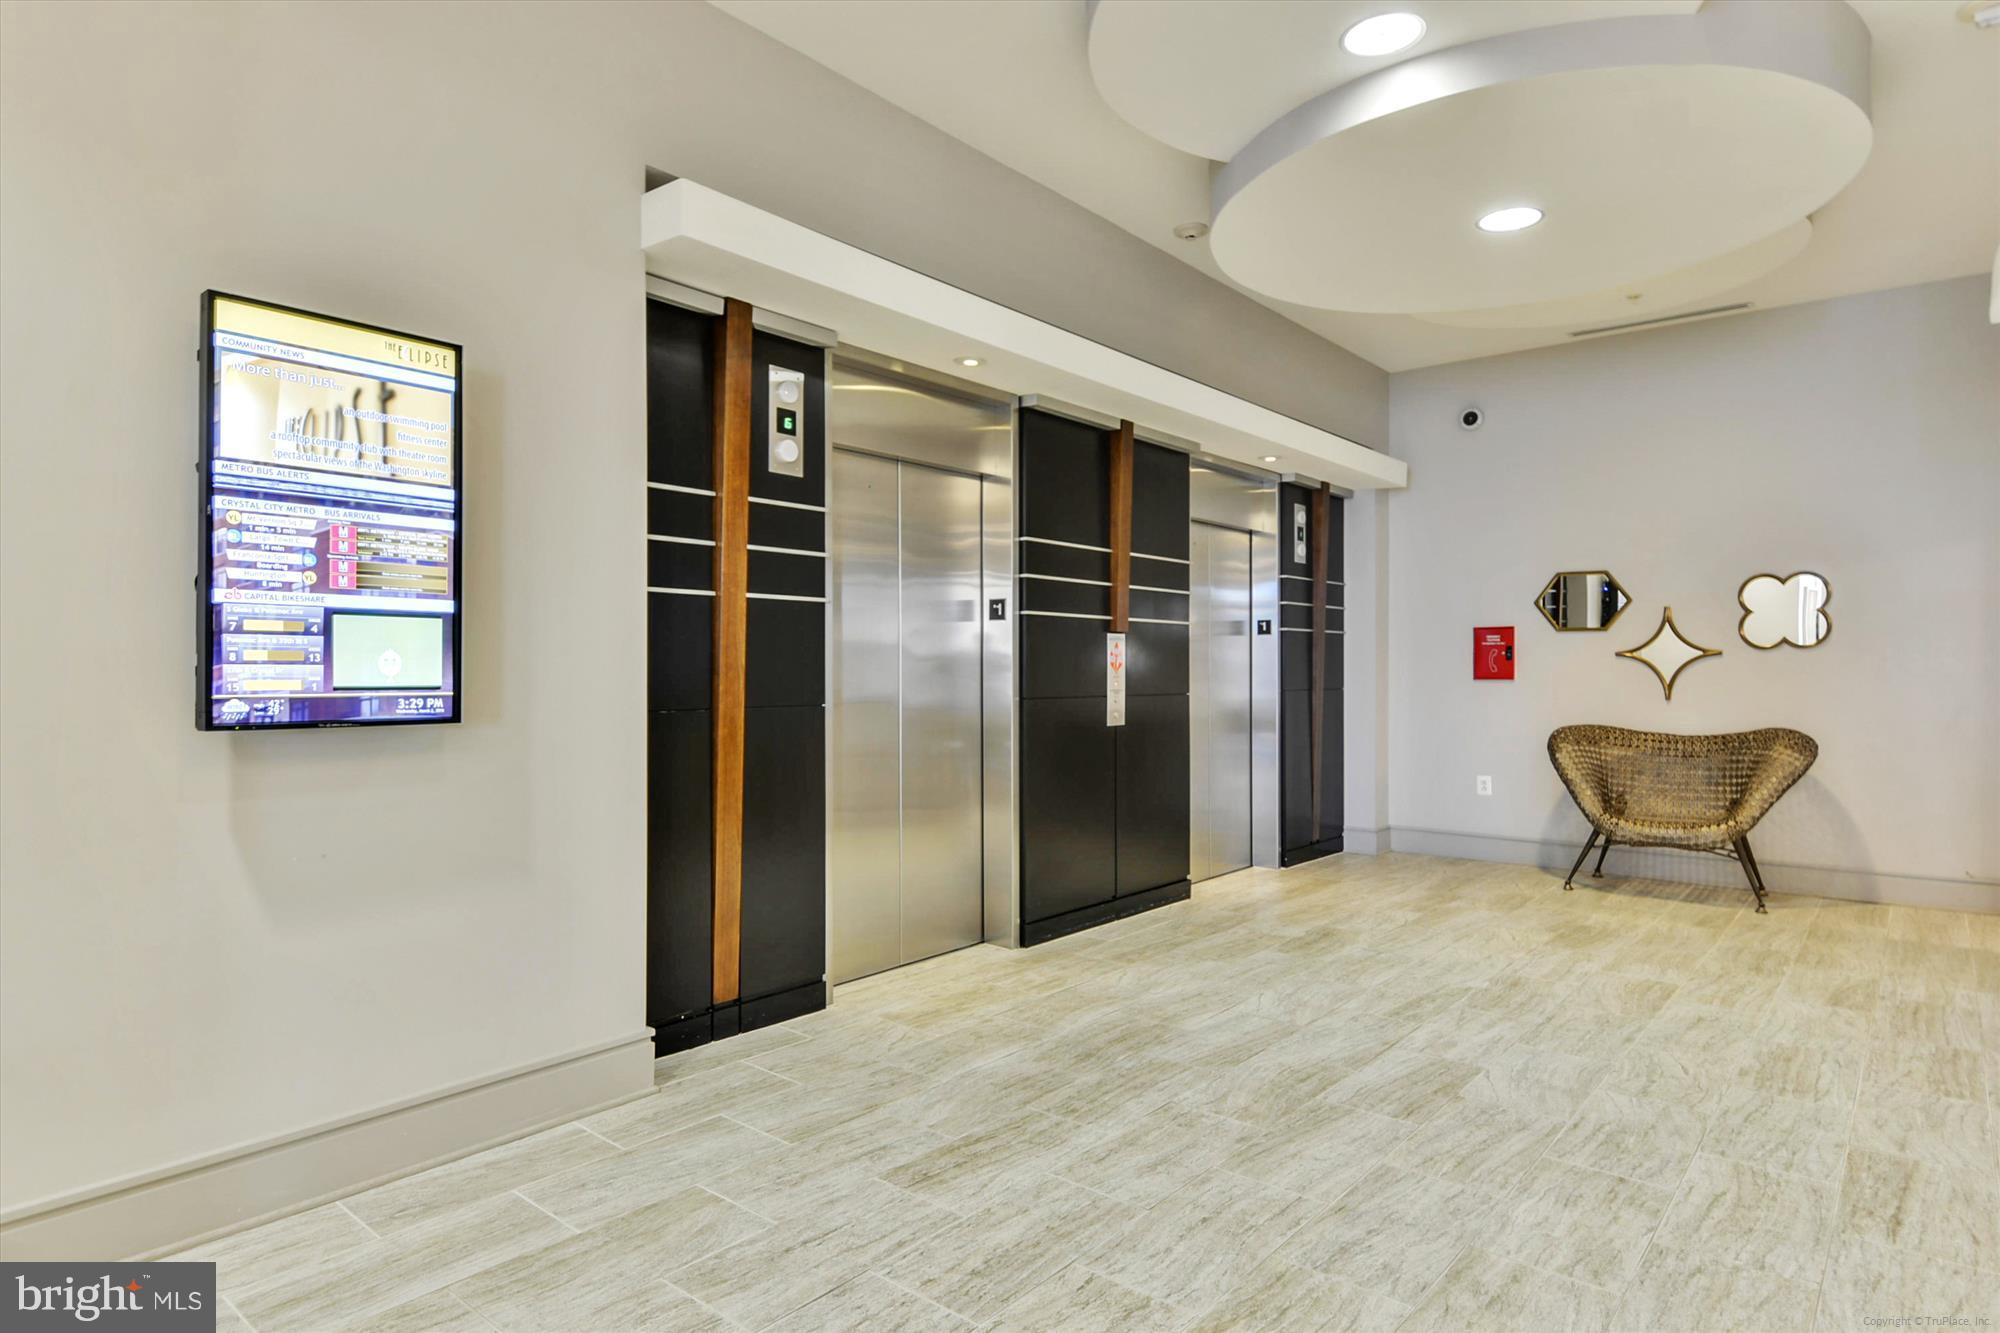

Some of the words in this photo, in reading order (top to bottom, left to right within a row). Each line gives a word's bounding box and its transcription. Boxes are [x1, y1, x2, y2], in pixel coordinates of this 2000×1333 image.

[222, 337, 277, 353] COMMUNITY
[280, 348, 305, 360] NEWS
[231, 360, 271, 376] More
[275, 367, 306, 383] than
[356, 410, 389, 422] outdoor
[389, 416, 430, 431] swimming
[430, 422, 448, 432] pool
[783, 417, 793, 430] 6
[270, 431, 276, 440] a
[278, 432, 311, 446] rooftop
[312, 437, 359, 452] community
[399, 449, 426, 460] theatre
[427, 454, 447, 463] room
[424, 438, 448, 448] center
[272, 449, 322, 463] spectacular
[323, 456, 348, 467] views
[374, 461, 421, 477] Washington
[422, 468, 448, 480] skyline
[221, 463, 254, 473] METRO
[256, 466, 274, 476] BUS
[276, 469, 310, 480] ALERTS
[221, 498, 259, 509] CRYSTAL
[264, 503, 283, 512] CITY
[286, 505, 316, 515] METRO
[324, 509, 341, 518] BUS
[343, 511, 381, 522] ARRIVALS
[244, 593, 280, 601] CAPITAL
[282, 594, 325, 603] BIKESHARE
[229, 622, 237, 631] 7
[311, 624, 318, 633] 4
[1260, 621, 1267, 631] 1
[229, 652, 236, 661] 8
[308, 653, 320, 662] 13
[226, 683, 240, 692] 15
[398, 698, 424, 709] 3:29
[427, 698, 443, 708] PM
